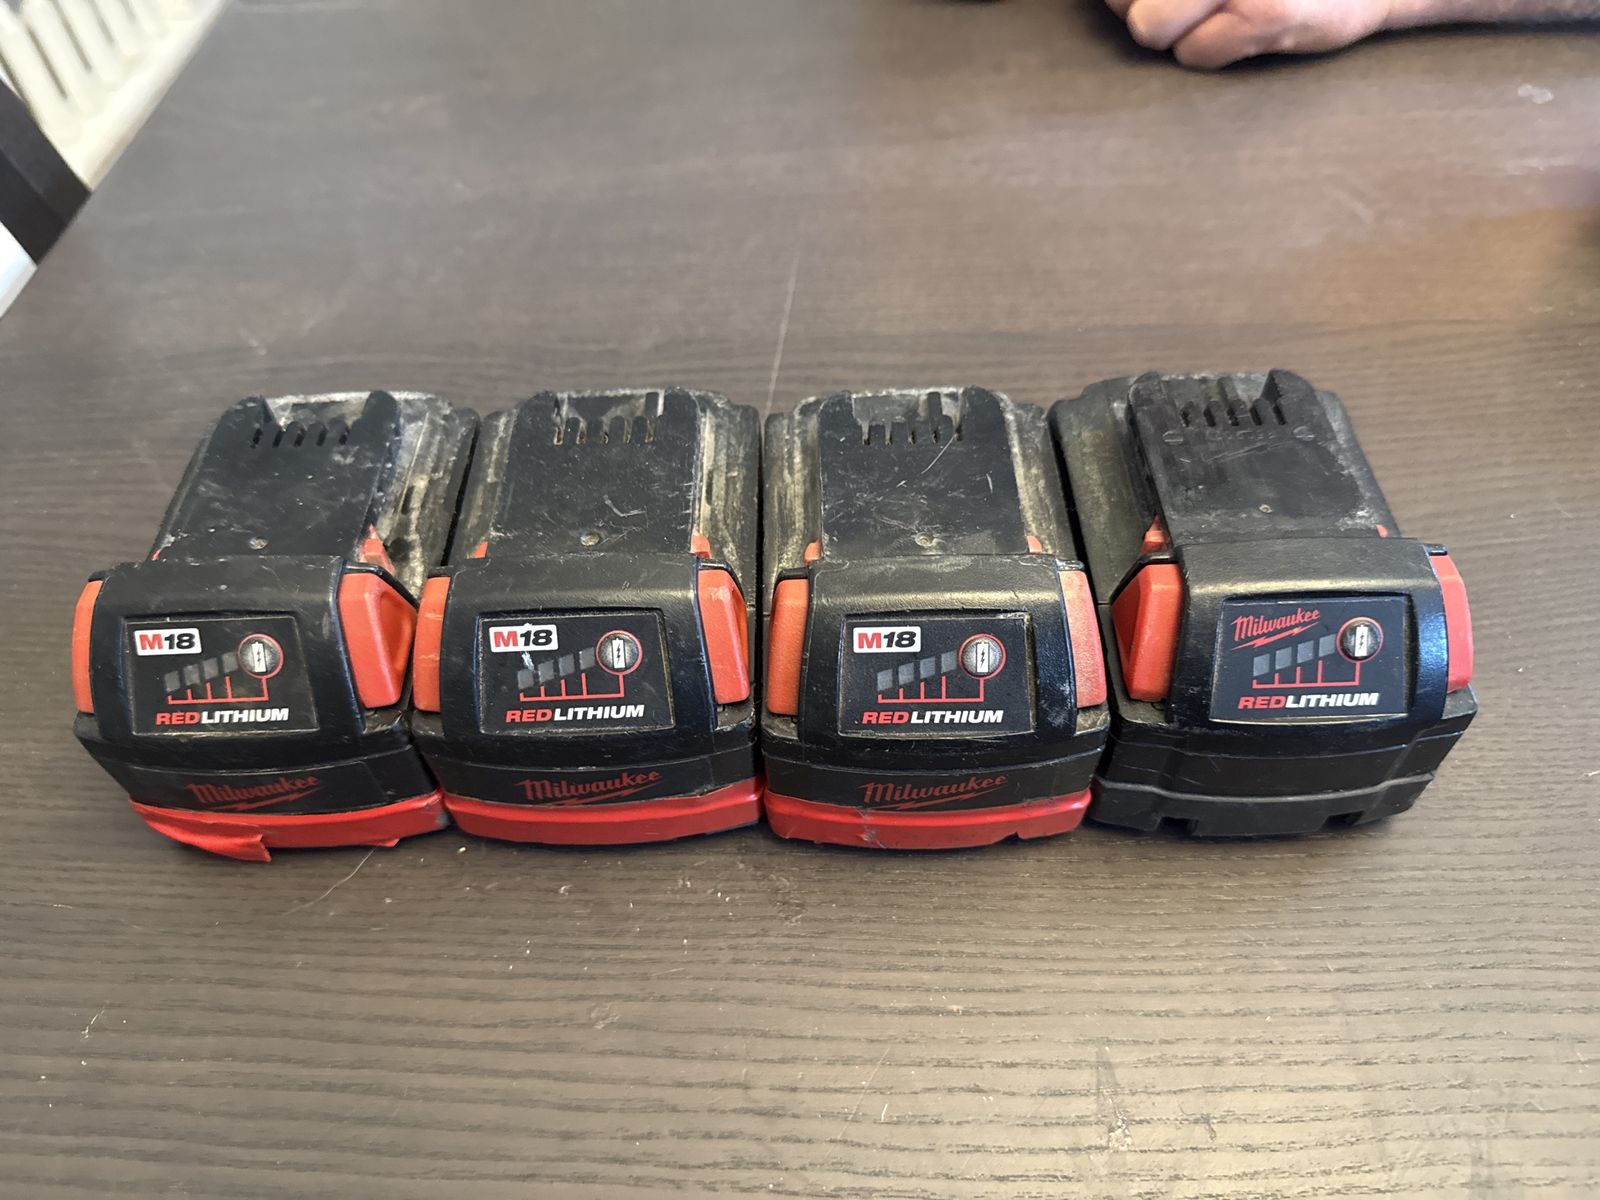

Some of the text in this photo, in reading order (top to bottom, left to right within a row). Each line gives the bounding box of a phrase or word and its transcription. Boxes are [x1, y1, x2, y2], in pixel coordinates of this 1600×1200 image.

[1232, 608, 1320, 641] Milwaukee
[139, 633, 196, 650] M18
[494, 629, 552, 647] M18
[858, 631, 916, 649] M18
[1238, 692, 1379, 709] REDLITHIUM
[156, 708, 289, 725] REDLITHIUM
[188, 776, 319, 803] Milwaukee
[517, 770, 661, 800] Milwaukee
[858, 775, 1007, 803] Milwaukee
